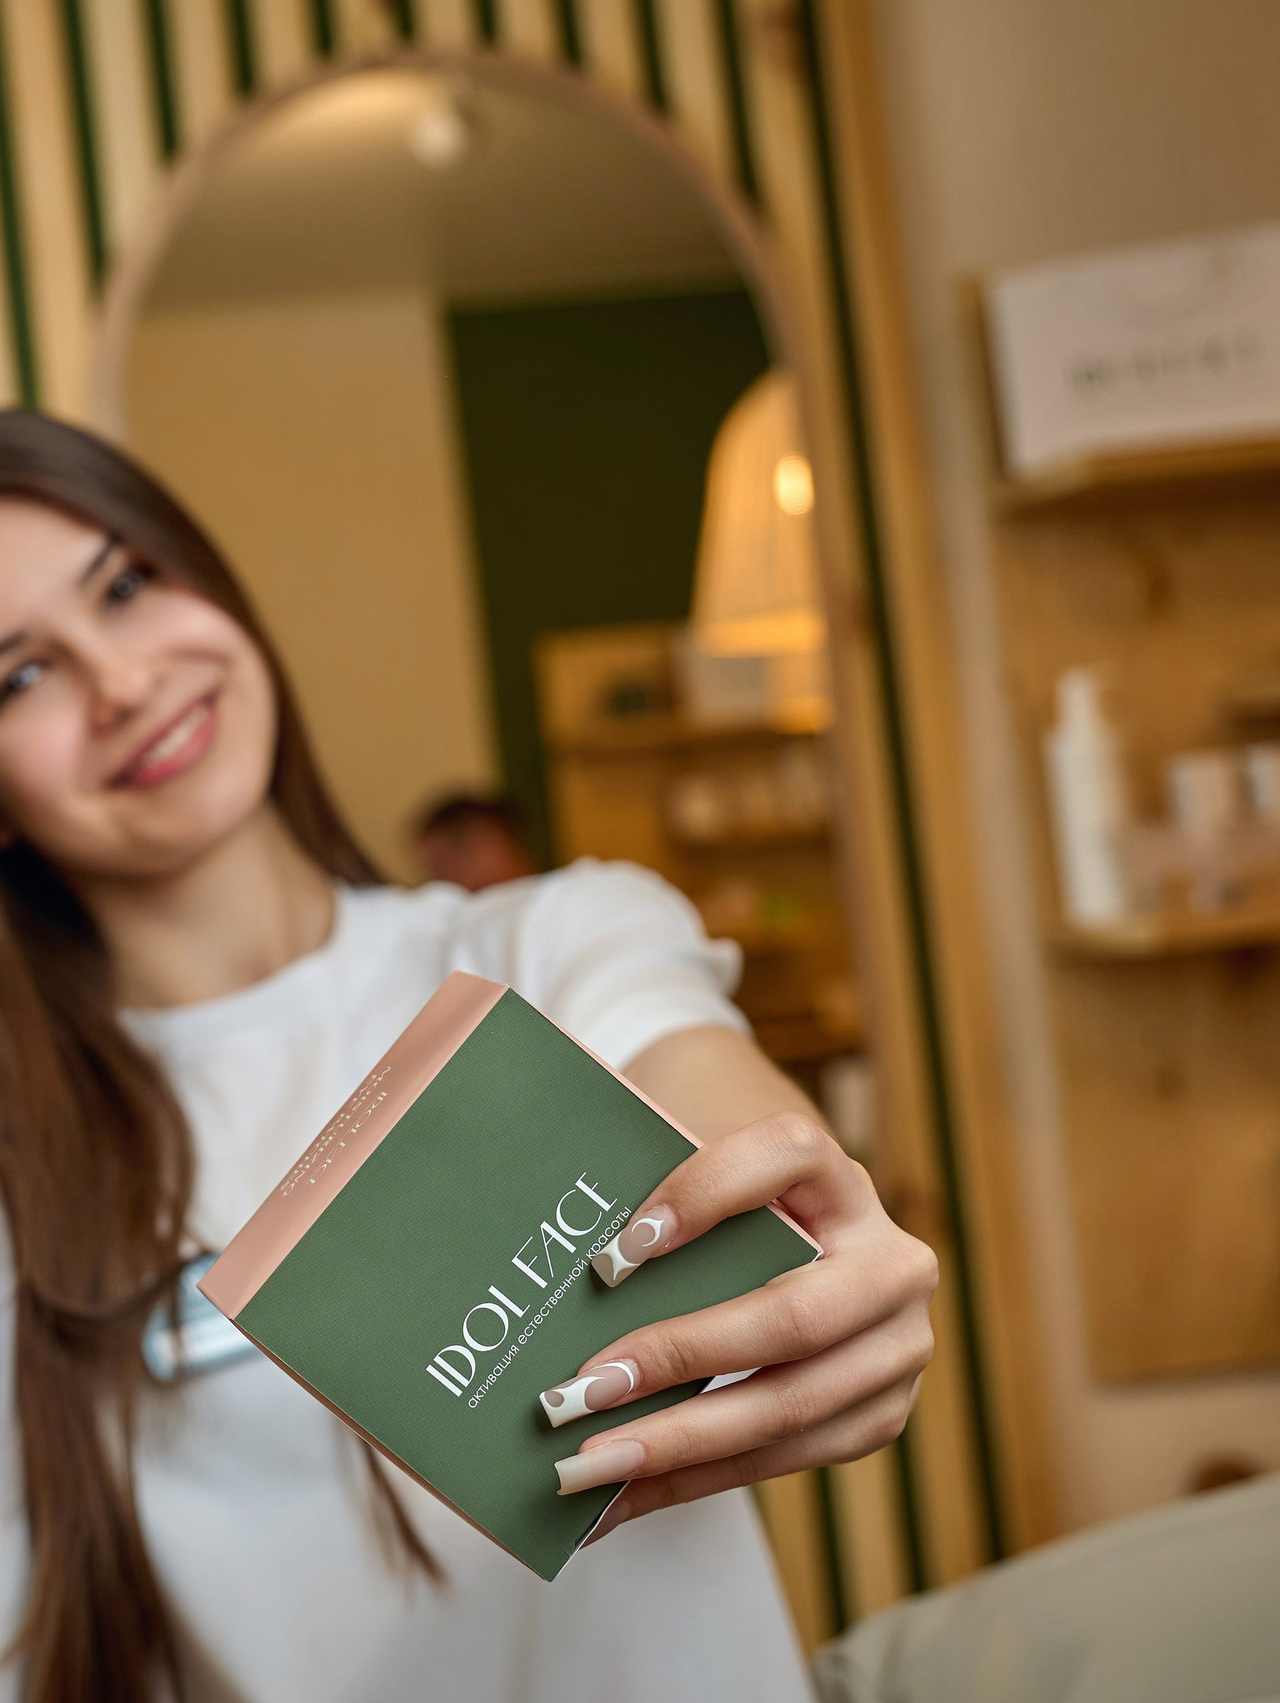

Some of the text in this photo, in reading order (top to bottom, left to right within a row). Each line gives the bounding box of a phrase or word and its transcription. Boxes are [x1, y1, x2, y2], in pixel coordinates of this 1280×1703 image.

[426, 1171, 617, 1397] IDOL FACE
[468, 1206, 632, 1409] активация естественной красоты
